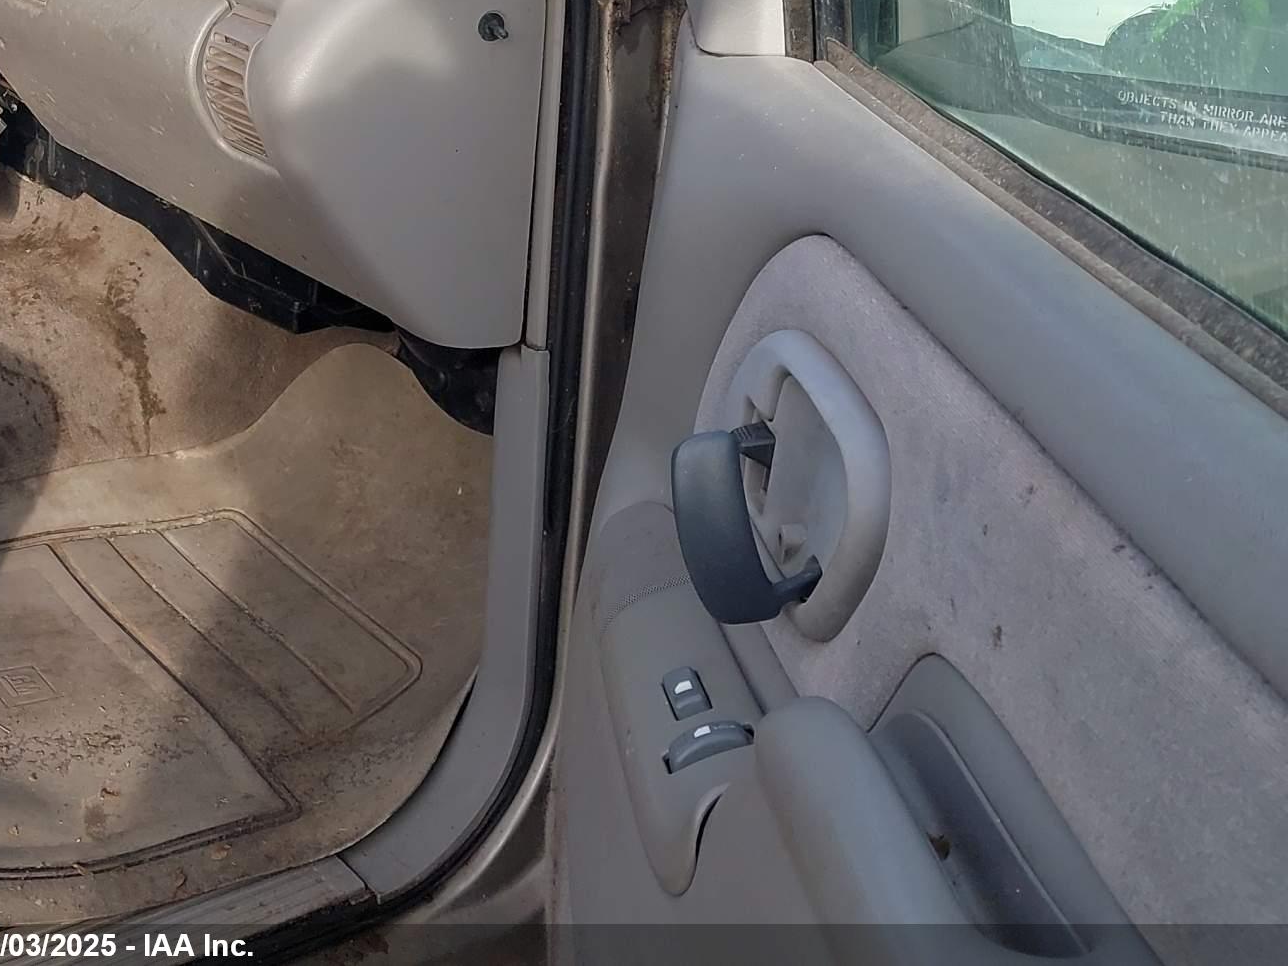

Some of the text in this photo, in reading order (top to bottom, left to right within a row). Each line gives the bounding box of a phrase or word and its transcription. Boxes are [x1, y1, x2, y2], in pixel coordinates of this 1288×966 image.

[1117, 90, 1288, 129] OBJECTS IN MIRROR ARE
[1160, 111, 1196, 128] THAN
[1202, 120, 1238, 134] THEY
